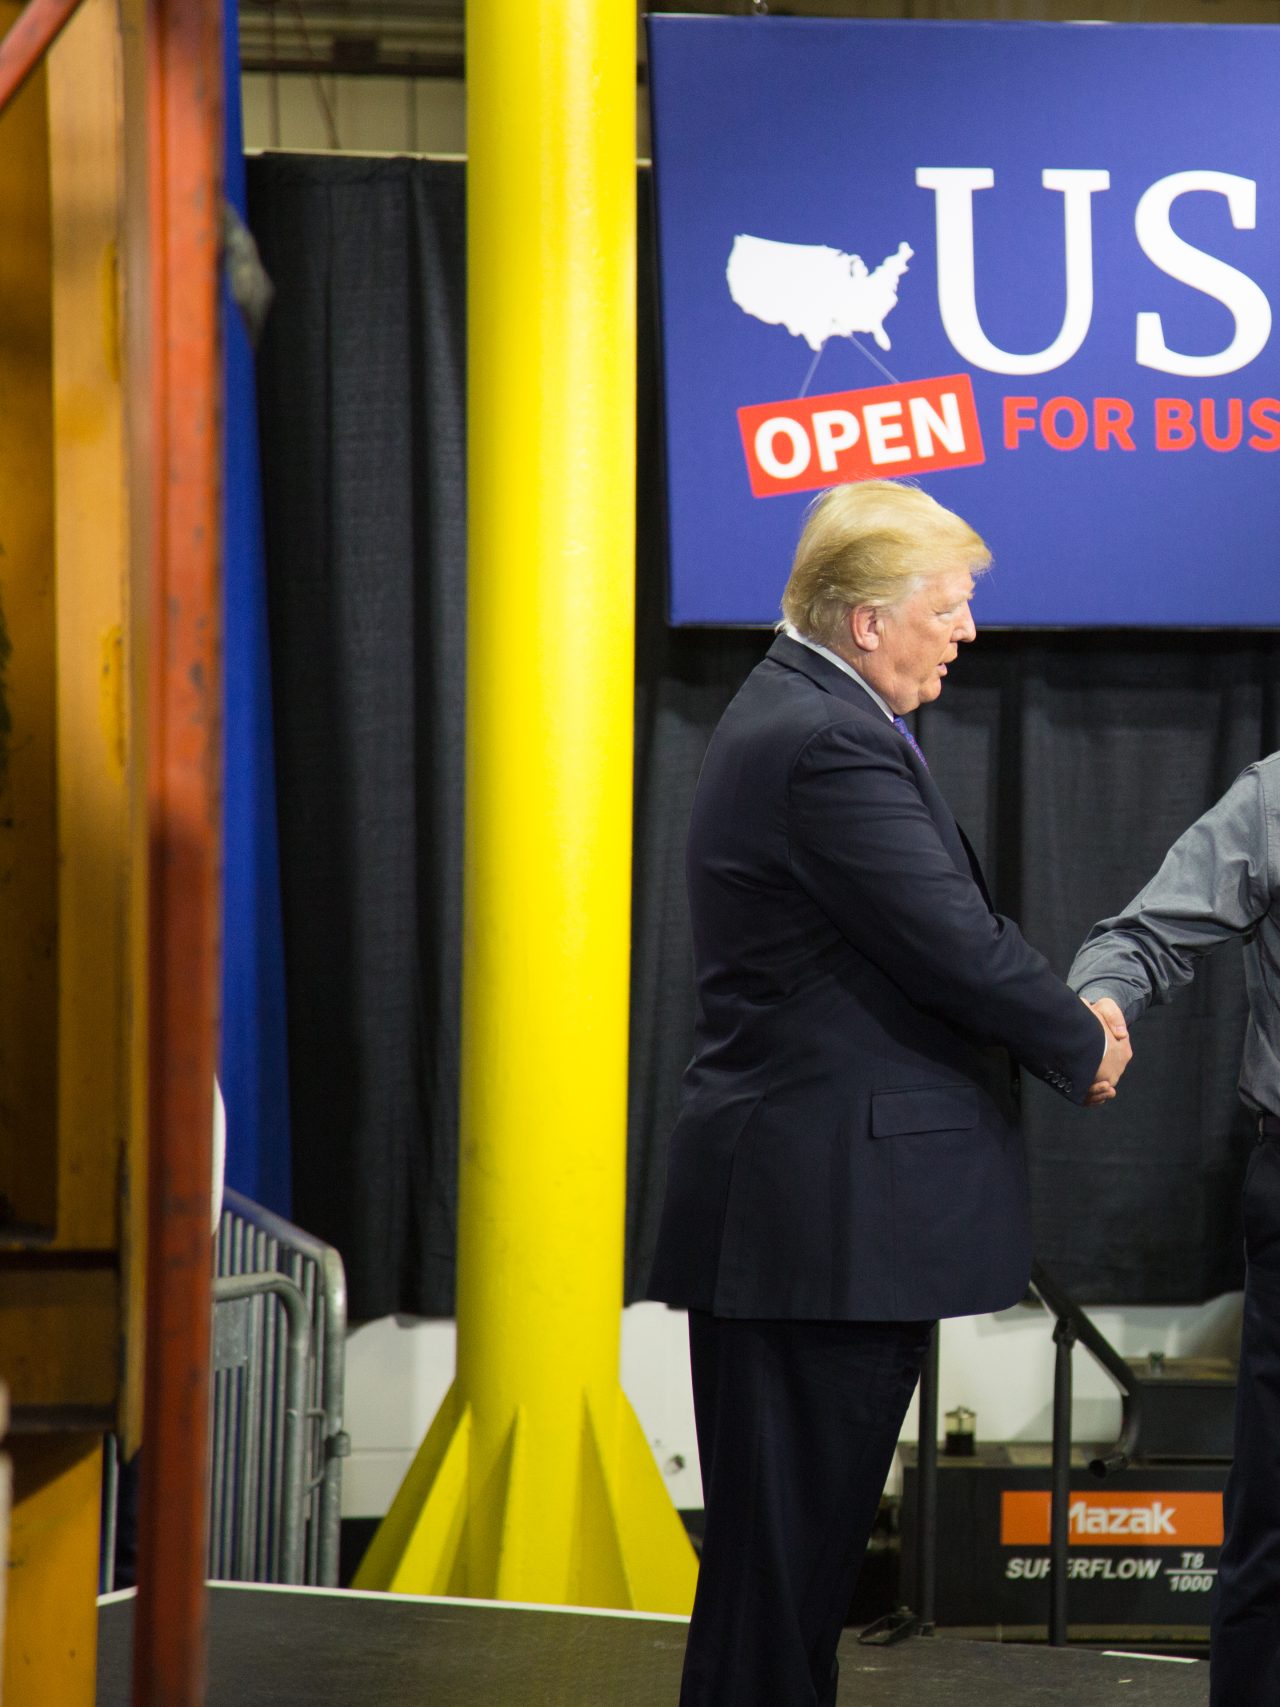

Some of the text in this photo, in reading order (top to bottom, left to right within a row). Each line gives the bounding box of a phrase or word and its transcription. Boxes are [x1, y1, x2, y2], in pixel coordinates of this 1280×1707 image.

[754, 392, 966, 480] OPEN
[1003, 396, 1136, 451] FOR
[1169, 1575, 1214, 1593] 1000
